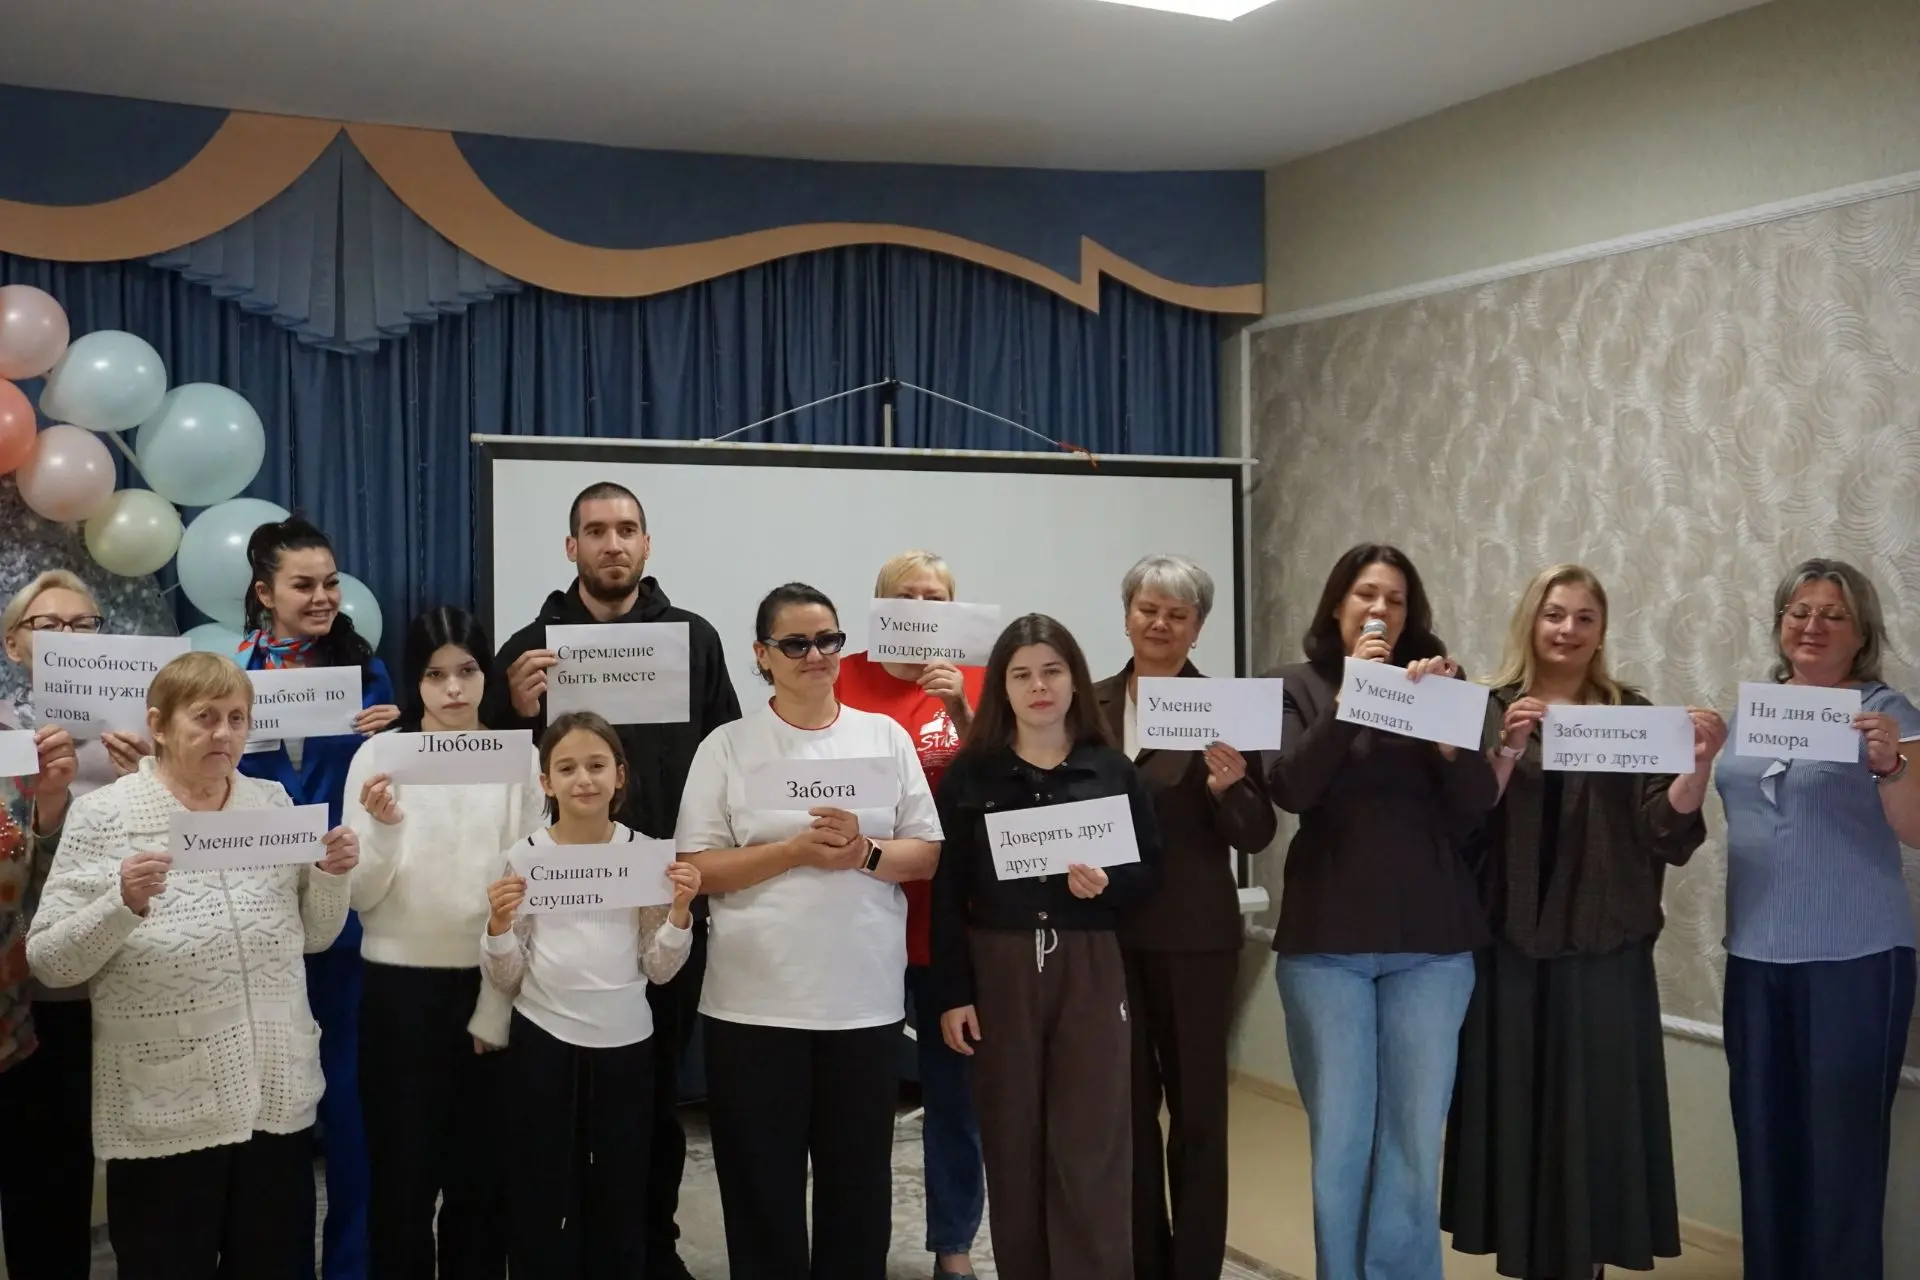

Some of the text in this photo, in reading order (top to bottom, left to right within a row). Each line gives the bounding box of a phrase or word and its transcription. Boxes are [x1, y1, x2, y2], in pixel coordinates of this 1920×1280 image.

[879, 616, 939, 634] Умение
[557, 644, 655, 662] Стремление
[877, 643, 967, 660] поддержать
[44, 651, 158, 672] Способность
[557, 670, 656, 685] быть вместе
[44, 680, 147, 701] найти нужн
[253, 687, 345, 705] лыбкой по
[1354, 677, 1416, 706] Умение
[1147, 696, 1213, 713] Умение
[1750, 701, 1851, 724] Ни дня без
[44, 707, 91, 722] слова
[1349, 706, 1414, 732] молчать
[252, 718, 280, 730] зни
[1147, 725, 1220, 740] слышать
[1553, 722, 1648, 741] Заботиться
[418, 733, 504, 754] Любовь
[1747, 731, 1810, 749] юмора
[1553, 752, 1660, 770] друг о друге
[786, 780, 857, 800] Забота
[183, 830, 318, 851] Умение понять
[1000, 821, 1115, 848] Доверять друг
[530, 864, 629, 882] Слышать и
[1005, 855, 1049, 873] другу
[529, 892, 604, 910] слушать
